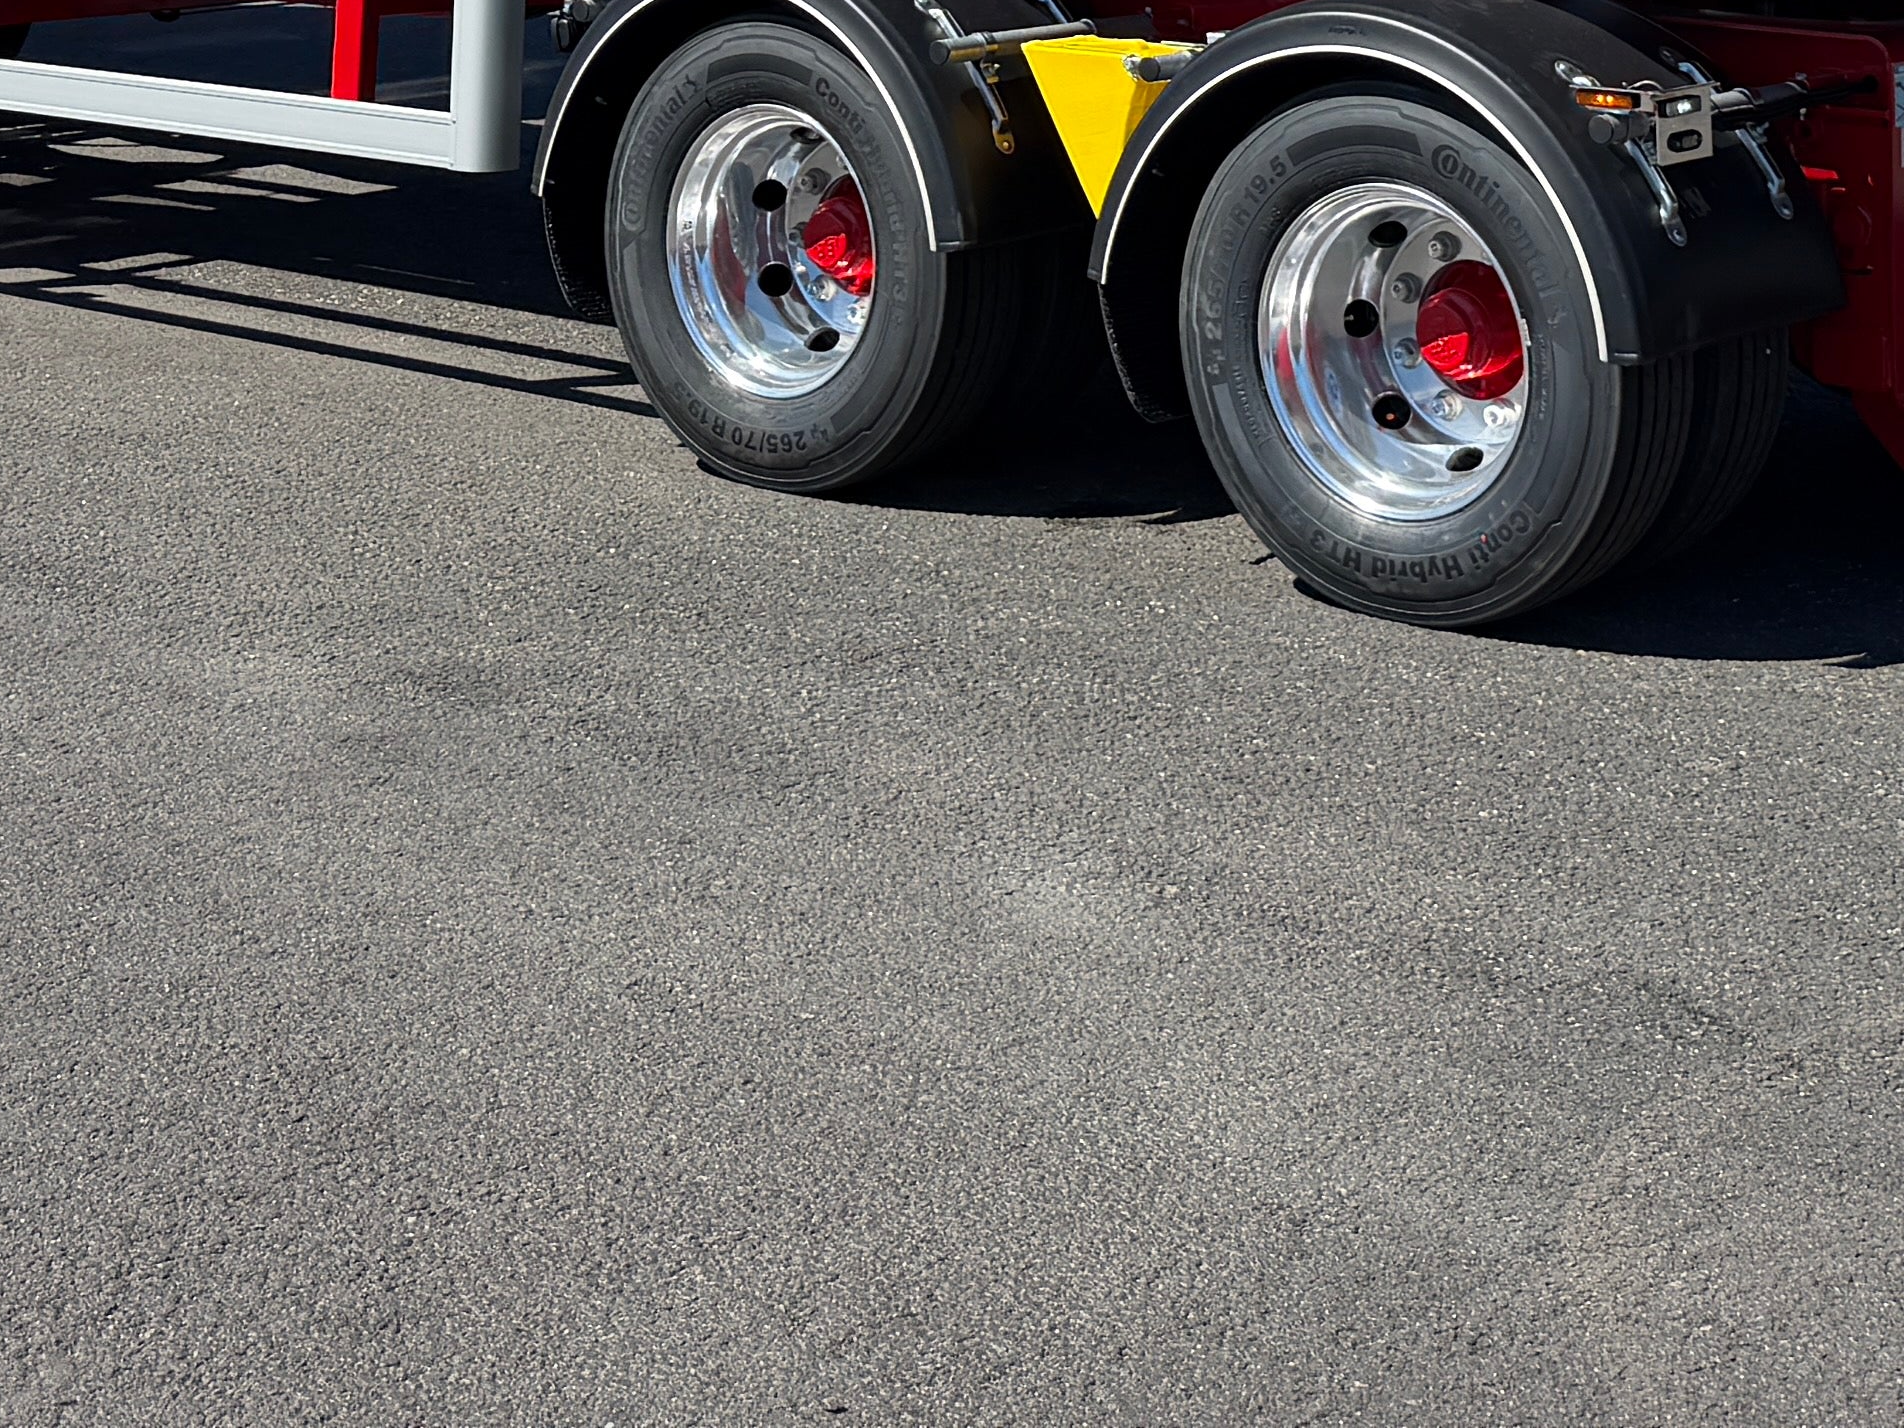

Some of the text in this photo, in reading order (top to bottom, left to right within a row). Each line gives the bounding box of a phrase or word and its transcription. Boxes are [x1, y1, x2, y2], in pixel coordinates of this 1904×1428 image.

[815, 76, 867, 135] Conti
[1244, 154, 1288, 202] 19.5
[1431, 144, 1561, 300] Continental
[731, 429, 808, 454] 265/70
[1469, 508, 1532, 570] Conti
[1371, 553, 1465, 584] Hybrid
